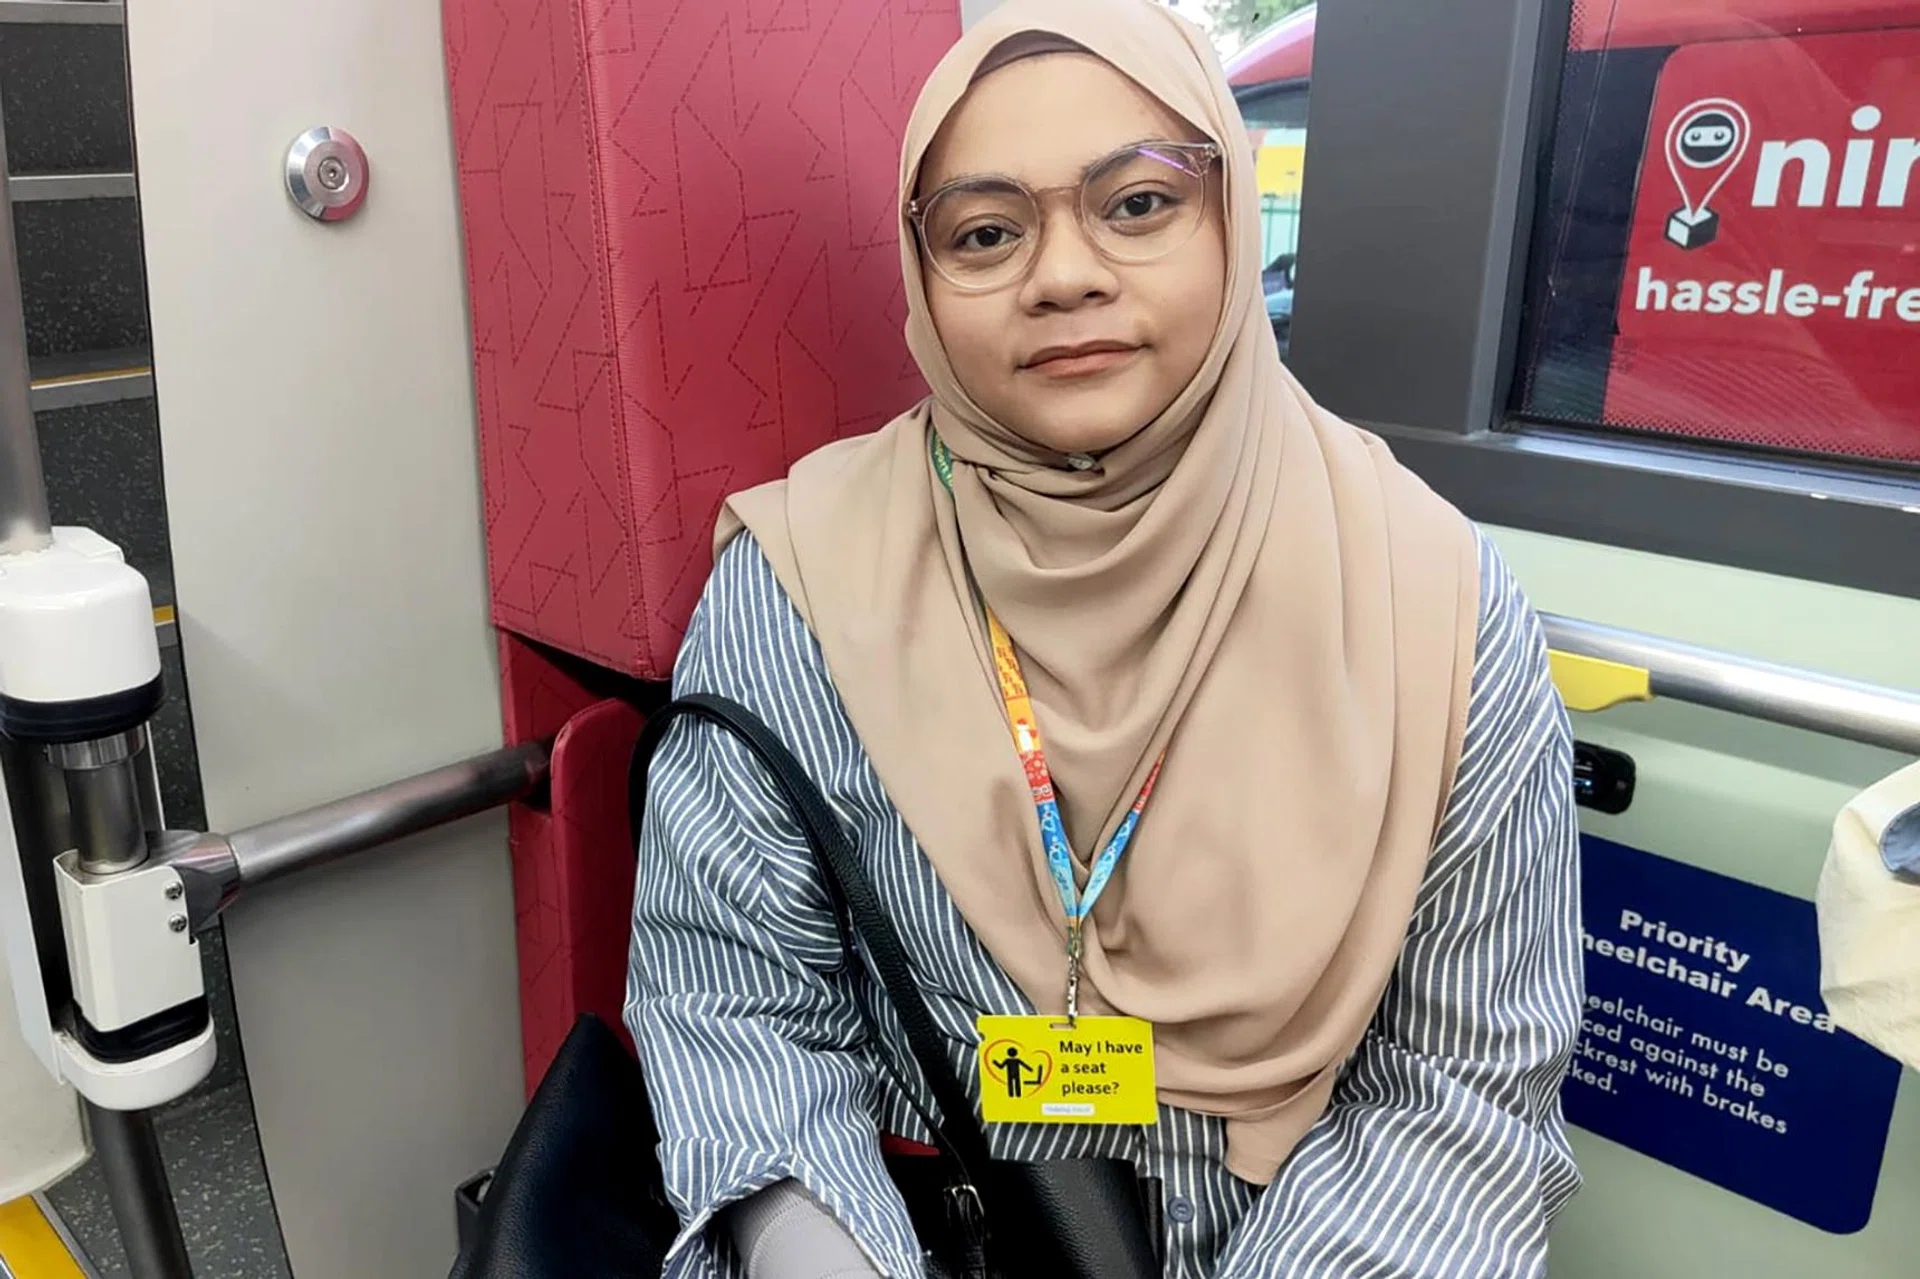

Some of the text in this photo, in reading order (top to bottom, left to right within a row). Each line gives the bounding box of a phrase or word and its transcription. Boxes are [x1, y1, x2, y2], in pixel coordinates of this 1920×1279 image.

[1619, 909, 1750, 973] Priority
[1580, 926, 1836, 1034] heelchair Area
[1059, 1041, 1143, 1057] May I have
[1060, 1062, 1106, 1074] a seat
[1580, 1017, 1765, 1097] ced against the
[1584, 993, 1789, 1078] eelchair must be
[1061, 1081, 1120, 1096] please?
[1573, 1037, 1788, 1134] ckrest with brakes
